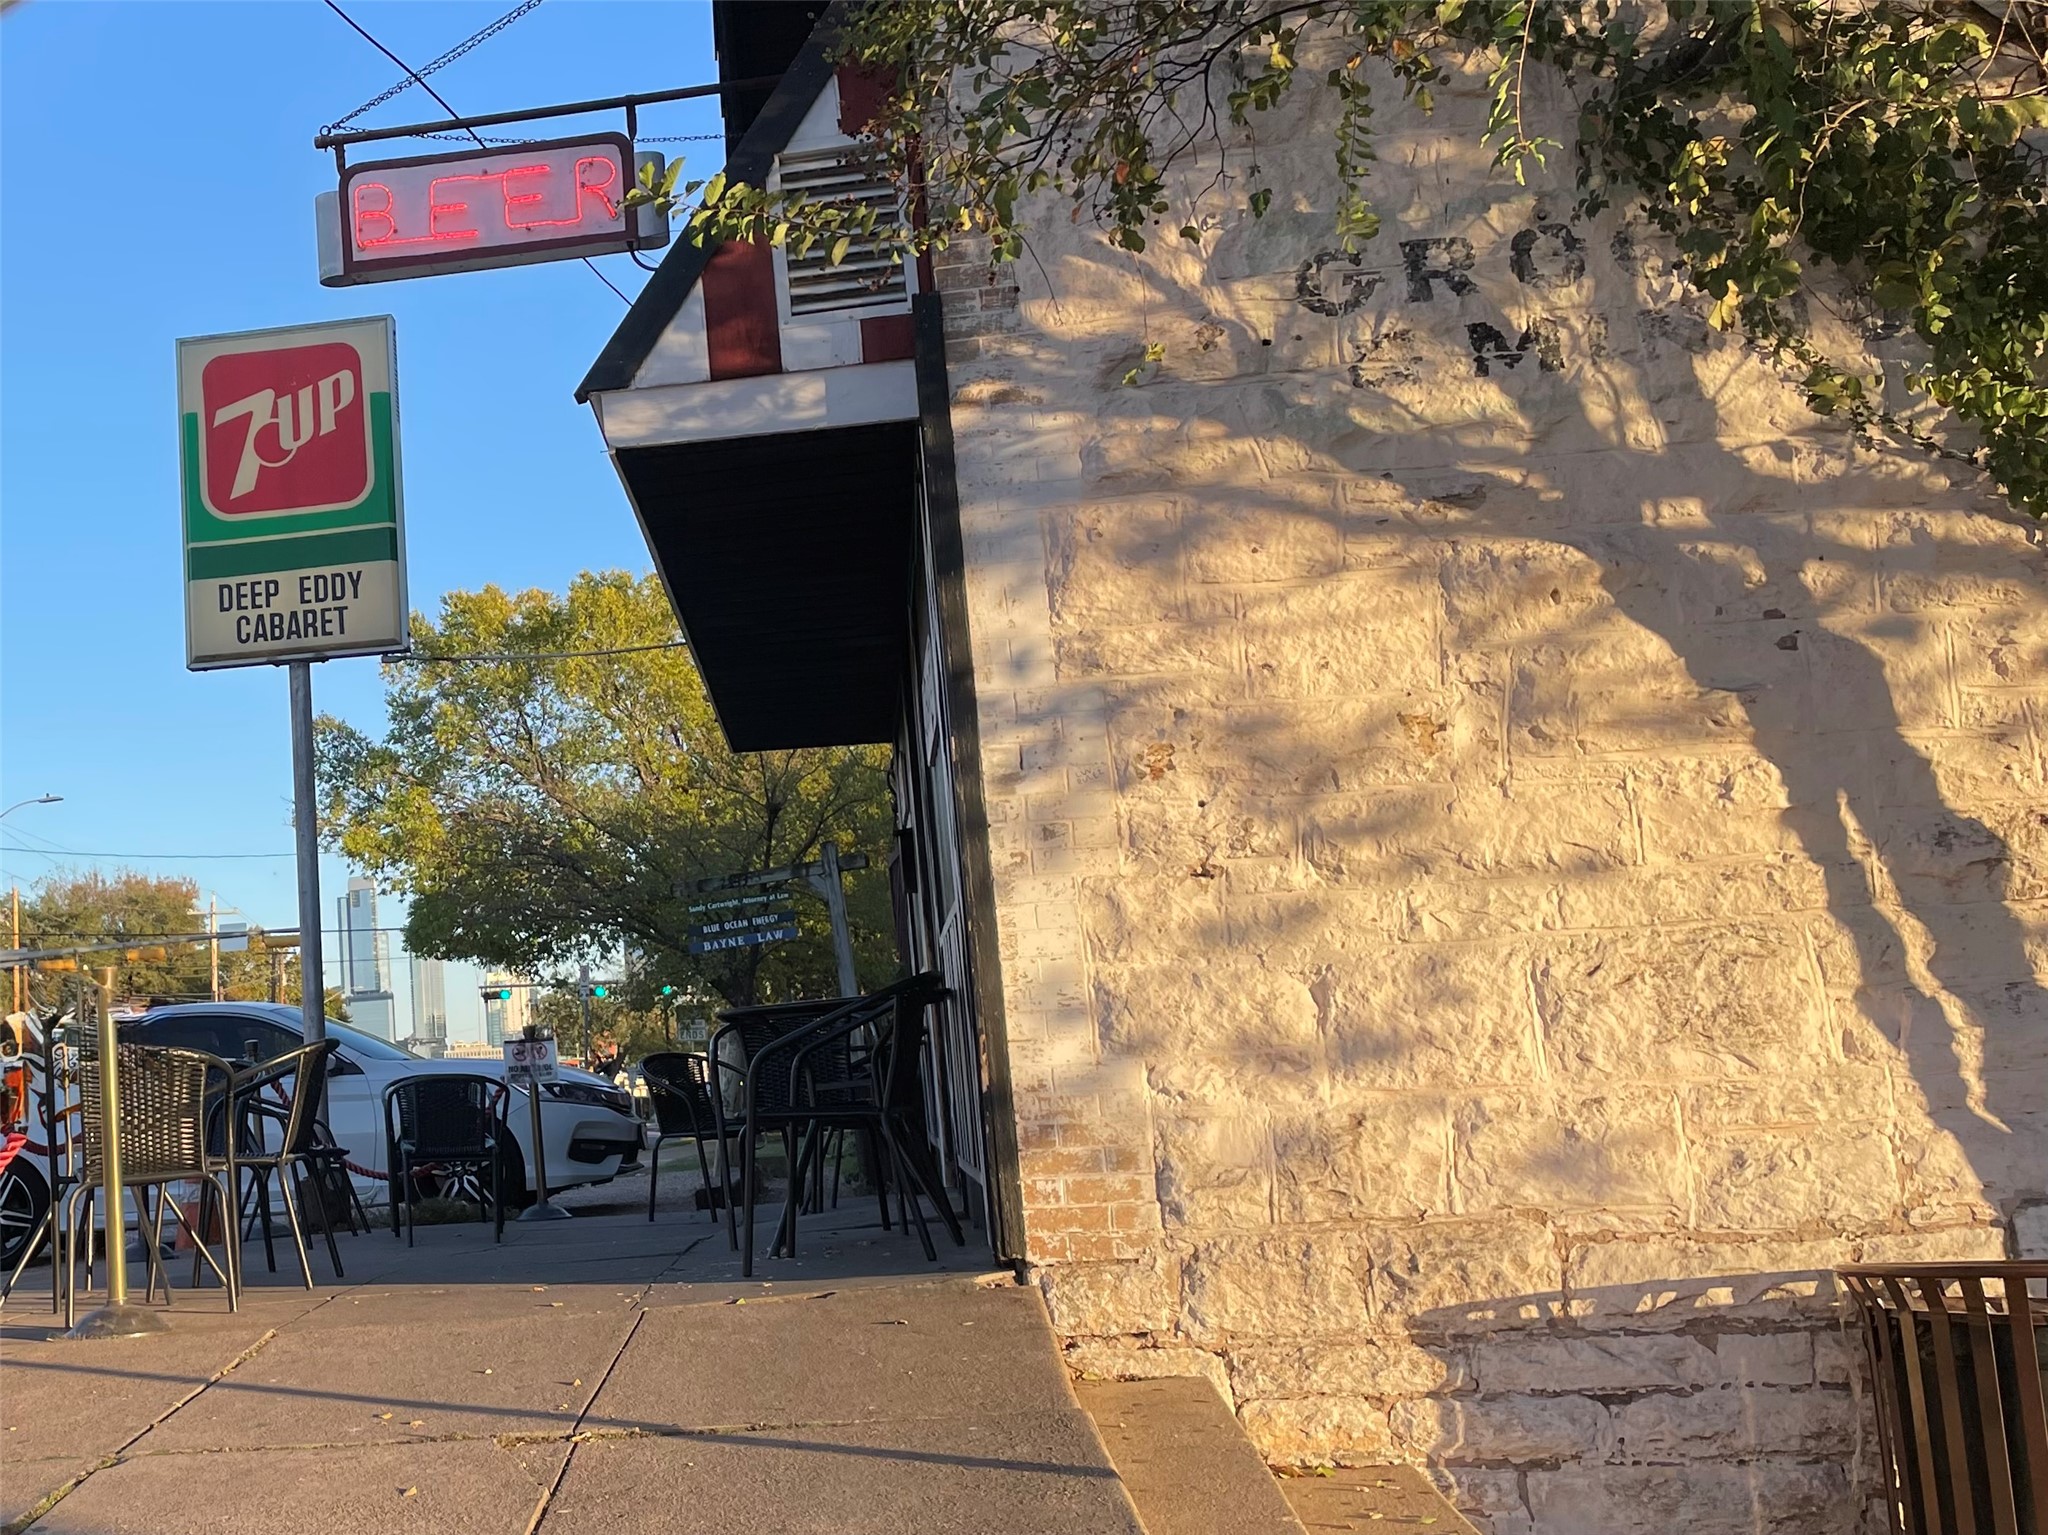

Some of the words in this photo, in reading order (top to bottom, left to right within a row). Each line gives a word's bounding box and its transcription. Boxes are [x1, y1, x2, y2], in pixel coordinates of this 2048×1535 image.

[354, 156, 618, 250] BEER
[218, 579, 280, 613] DEEP
[299, 570, 363, 605] EDDY
[236, 605, 349, 645] CABARET
[742, 895, 767, 905] Attorney
[702, 923, 720, 934] BLUE
[723, 919, 749, 930] OCEAN
[752, 914, 779, 926] ENERGY
[703, 936, 746, 951] BAYNE
[756, 929, 784, 943] LAW
[508, 1065, 519, 1074] NO
[520, 1063, 554, 1073] ALOL
